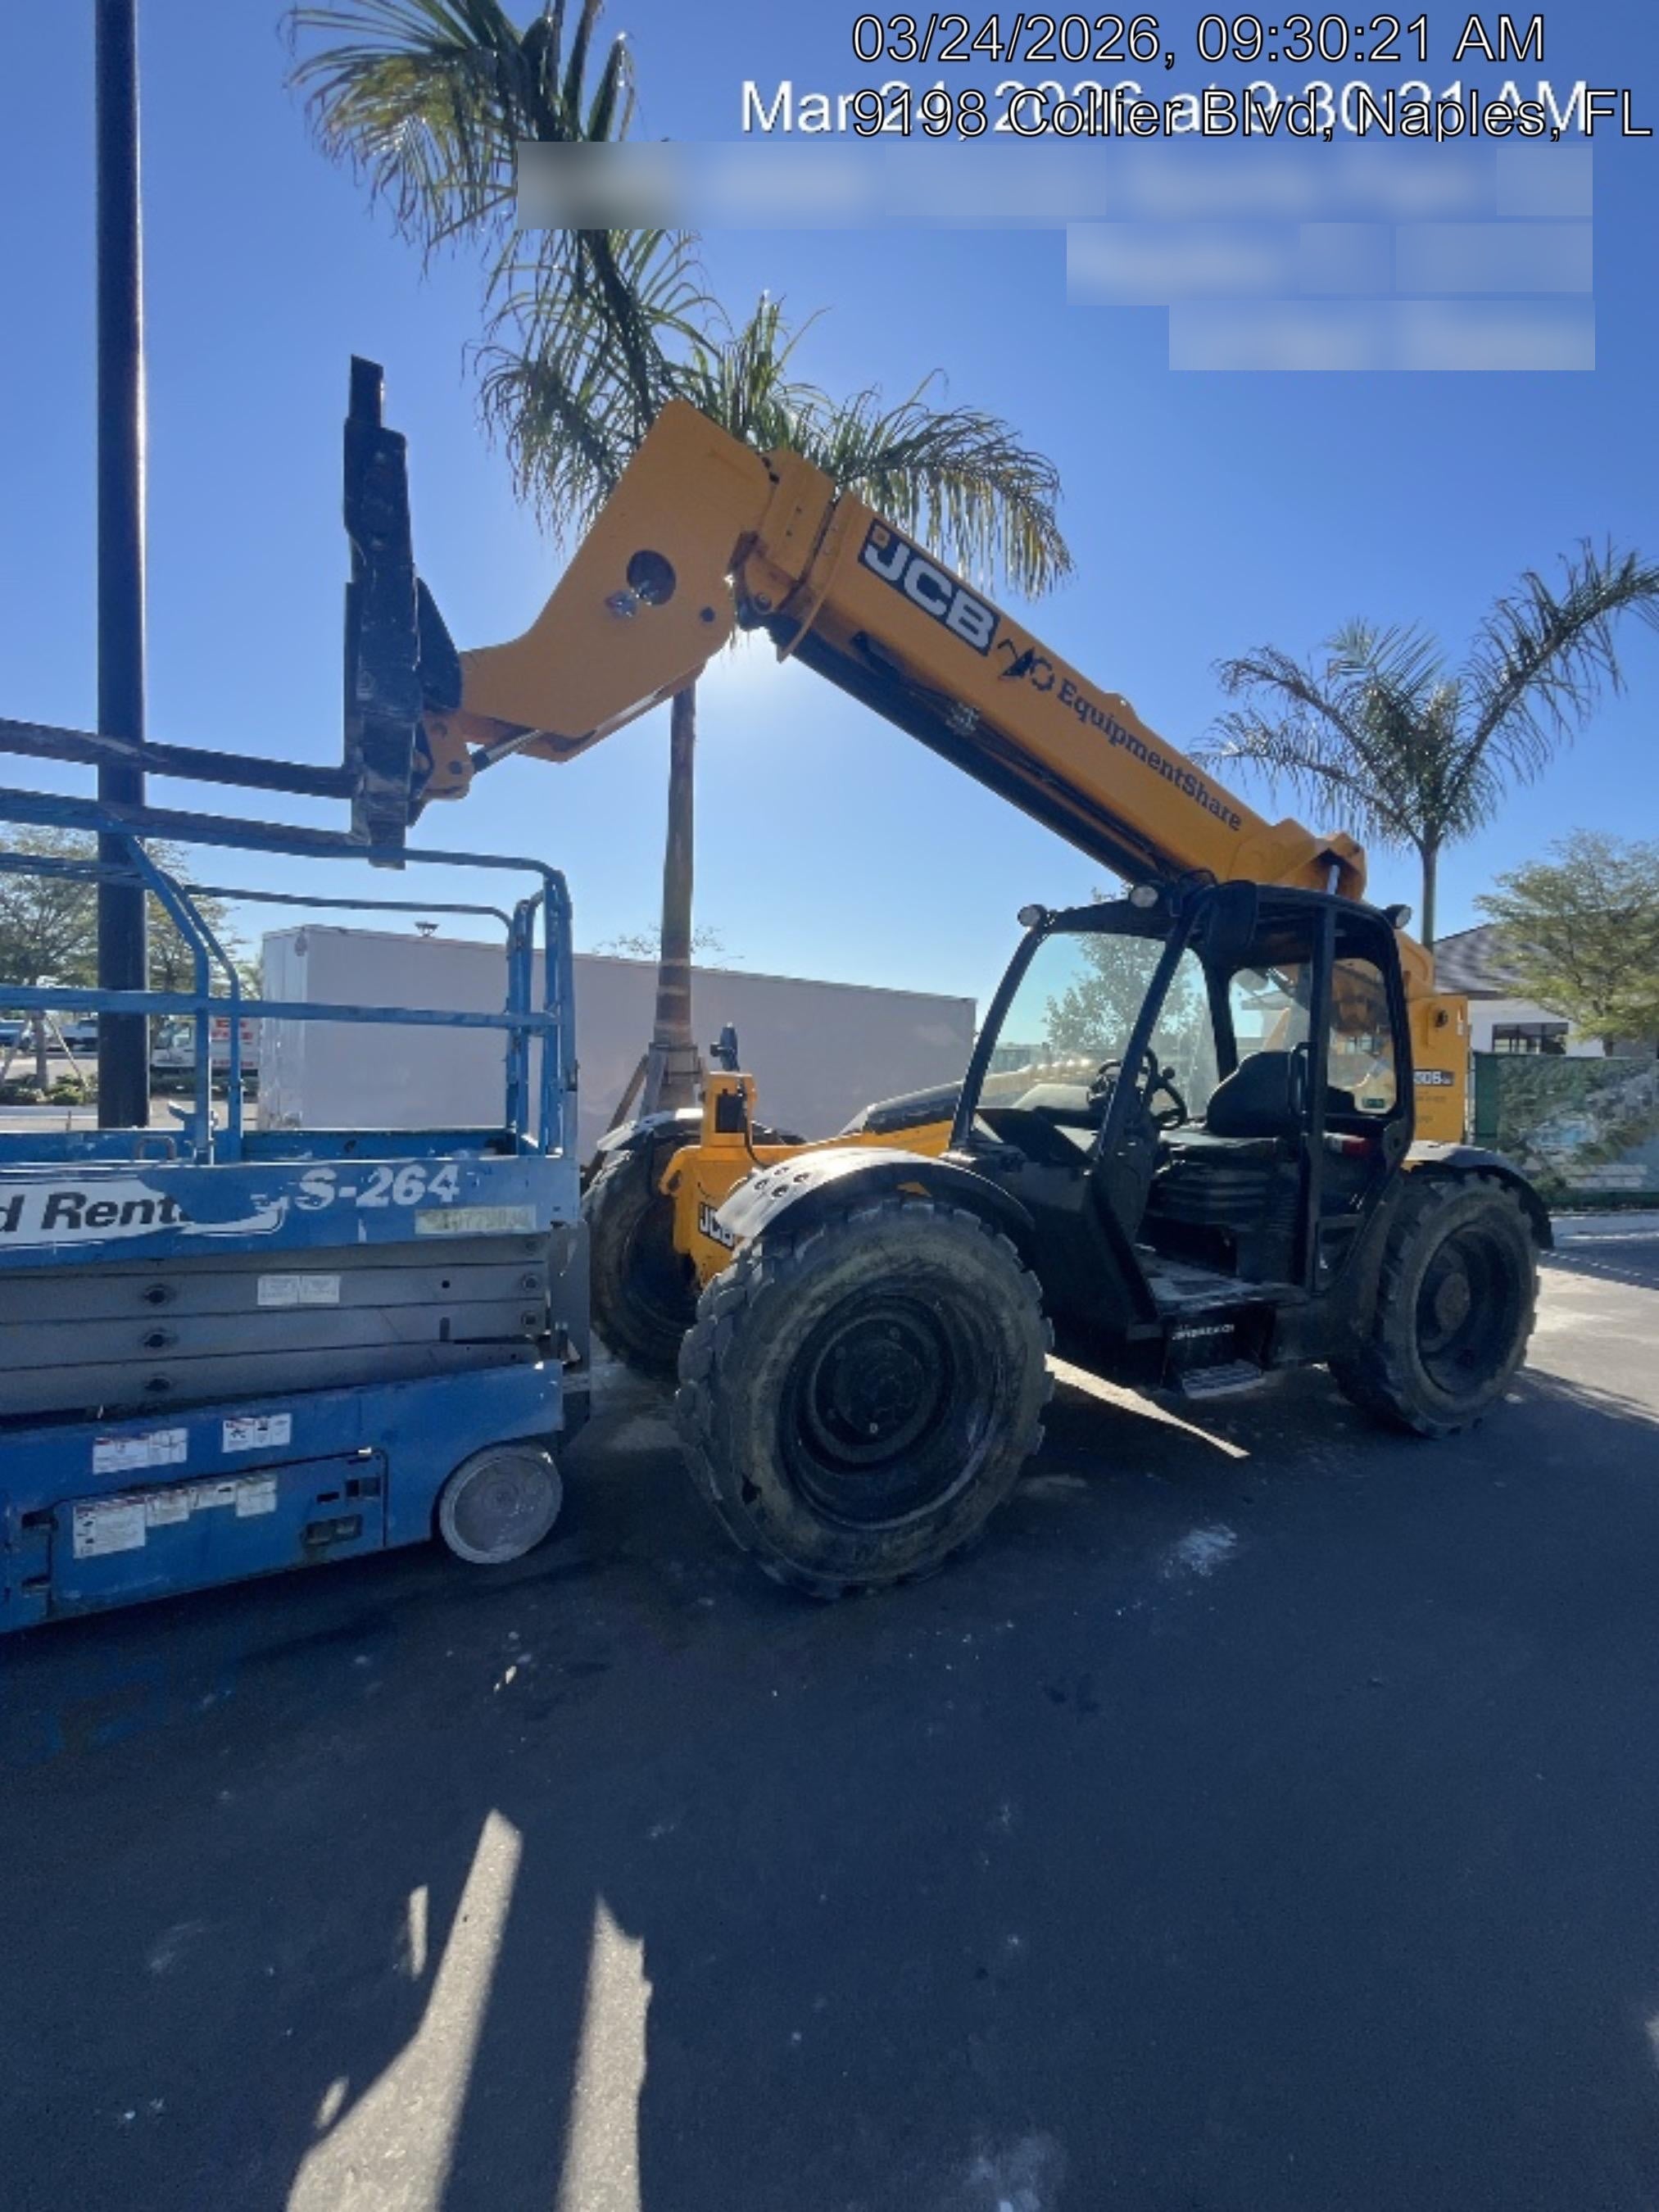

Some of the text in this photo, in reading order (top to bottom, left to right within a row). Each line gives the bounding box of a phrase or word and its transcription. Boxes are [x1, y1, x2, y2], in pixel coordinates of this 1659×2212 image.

[864, 525, 995, 649] JCB
[1057, 678, 1243, 832] EquipmentShare
[41, 1190, 191, 1230] Rent
